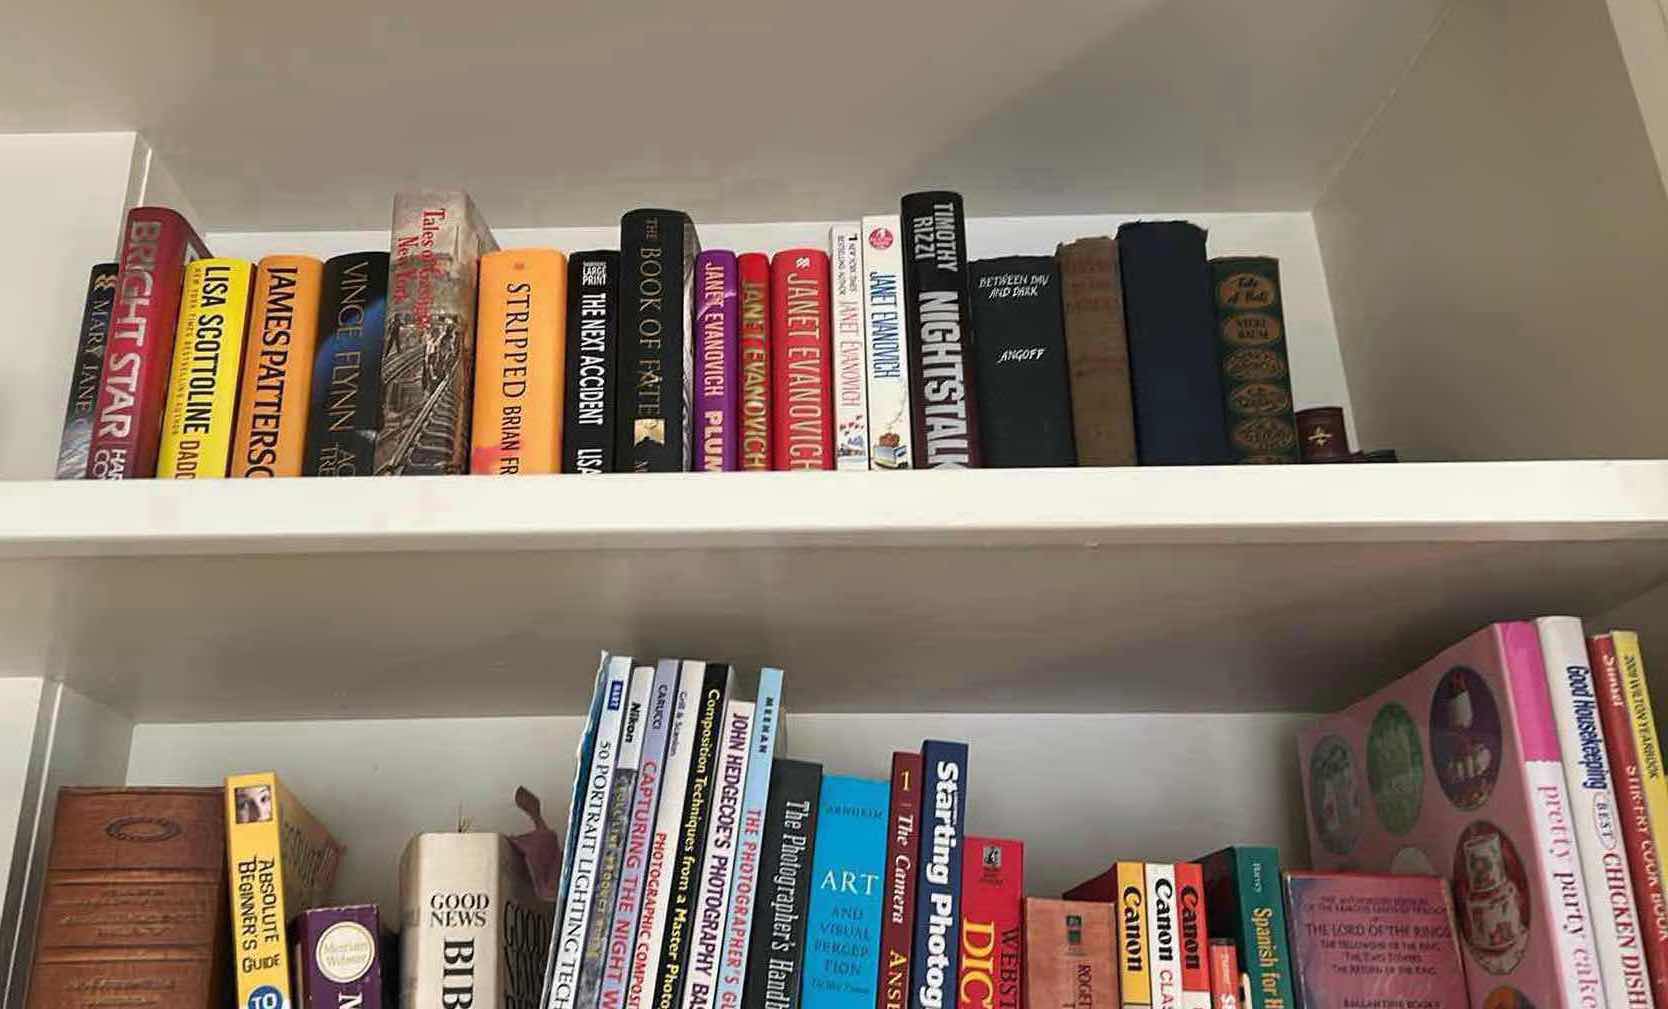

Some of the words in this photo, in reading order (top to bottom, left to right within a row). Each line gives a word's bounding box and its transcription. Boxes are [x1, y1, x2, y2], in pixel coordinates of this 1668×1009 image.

[422, 208, 447, 247] Tales
[913, 215, 936, 261] RIZZI
[933, 202, 959, 273] TIMOTHY
[113, 220, 161, 347] BRIGHT
[200, 266, 231, 308] LISA
[262, 267, 298, 346] JAMES
[335, 261, 369, 340] VINCE
[582, 292, 607, 318] THE
[638, 247, 664, 313] BOOK
[704, 261, 725, 308] JANET
[741, 280, 768, 341] JANET
[786, 272, 820, 340] JANET
[868, 271, 897, 308] JANET
[978, 274, 1028, 288] BETWEEN
[1030, 273, 1050, 286] DAY
[988, 286, 1011, 299] AND
[1012, 285, 1039, 297] DARK
[84, 299, 111, 355] MARY
[502, 282, 531, 398] STRIPPED
[580, 319, 607, 352] NEXT
[638, 319, 662, 352] OF
[839, 301, 861, 338] JANET
[870, 312, 901, 379] EVANOVICH
[183, 314, 224, 435] SCOTTOLINE
[703, 312, 725, 398] EVANOVICH
[839, 341, 864, 407] EVANOVICH
[997, 348, 1046, 364] ANGOFF
[75, 364, 97, 411] JANE
[99, 351, 142, 438] STAR
[327, 351, 361, 432] FLYNN
[578, 354, 606, 426] ACCIDENT
[638, 358, 664, 419] FATE
[742, 348, 768, 470] EVANOVICH
[787, 345, 823, 472] EVANOVICH
[500, 405, 522, 452] BRIAN
[91, 450, 111, 480] CO
[652, 684, 668, 730] CARUCCI
[1565, 665, 1595, 703] Good
[625, 701, 642, 744] Nikon
[696, 688, 721, 777] Composition
[728, 712, 751, 753] JOHN
[1574, 699, 1610, 790] Housekeeping
[582, 764, 611, 852] PORTRAIT
[626, 760, 657, 870] CAPTURING
[686, 773, 705, 853] Techniques
[714, 753, 745, 849] HEDGECOE'S
[744, 809, 762, 835] THE
[785, 801, 812, 831] The
[897, 814, 914, 848] The
[926, 761, 960, 885] Starting
[1537, 783, 1571, 859] pretty
[1595, 801, 1614, 840] BEST
[237, 855, 258, 952] BEGINNER'S
[257, 856, 280, 944] ABSOLUTE
[430, 892, 490, 911] GOOD
[619, 875, 639, 913] THE
[641, 832, 668, 940] PHOTOGRAPHIC
[676, 895, 687, 904] a
[678, 855, 697, 891] from
[770, 835, 807, 953] Photographer's
[820, 870, 880, 896] ART
[891, 855, 912, 924] Camera
[1602, 852, 1637, 951] CHICKEN
[430, 910, 488, 928] NEWS
[564, 858, 593, 954] LIGHTING
[667, 907, 689, 961] Master
[693, 855, 730, 978] PHOTOGRAPHY
[723, 840, 758, 985] PHOTOGRAPHER'S
[819, 922, 871, 940] VISUAL
[832, 905, 864, 920] AND
[1123, 886, 1143, 972] Canon
[1155, 878, 1174, 961] Canon
[1181, 885, 1200, 970] Canon
[1305, 923, 1328, 936] THE
[1332, 923, 1365, 937] LORD
[1385, 924, 1410, 937] THE
[1552, 871, 1586, 939] party
[241, 954, 281, 974] GUIDE
[608, 919, 631, 983] NIGHT
[824, 960, 862, 976] TION
[960, 917, 996, 1009] DIC
[1251, 907, 1279, 968] Spanish
[442, 935, 475, 1009] BIB
[1261, 973, 1281, 996] for
